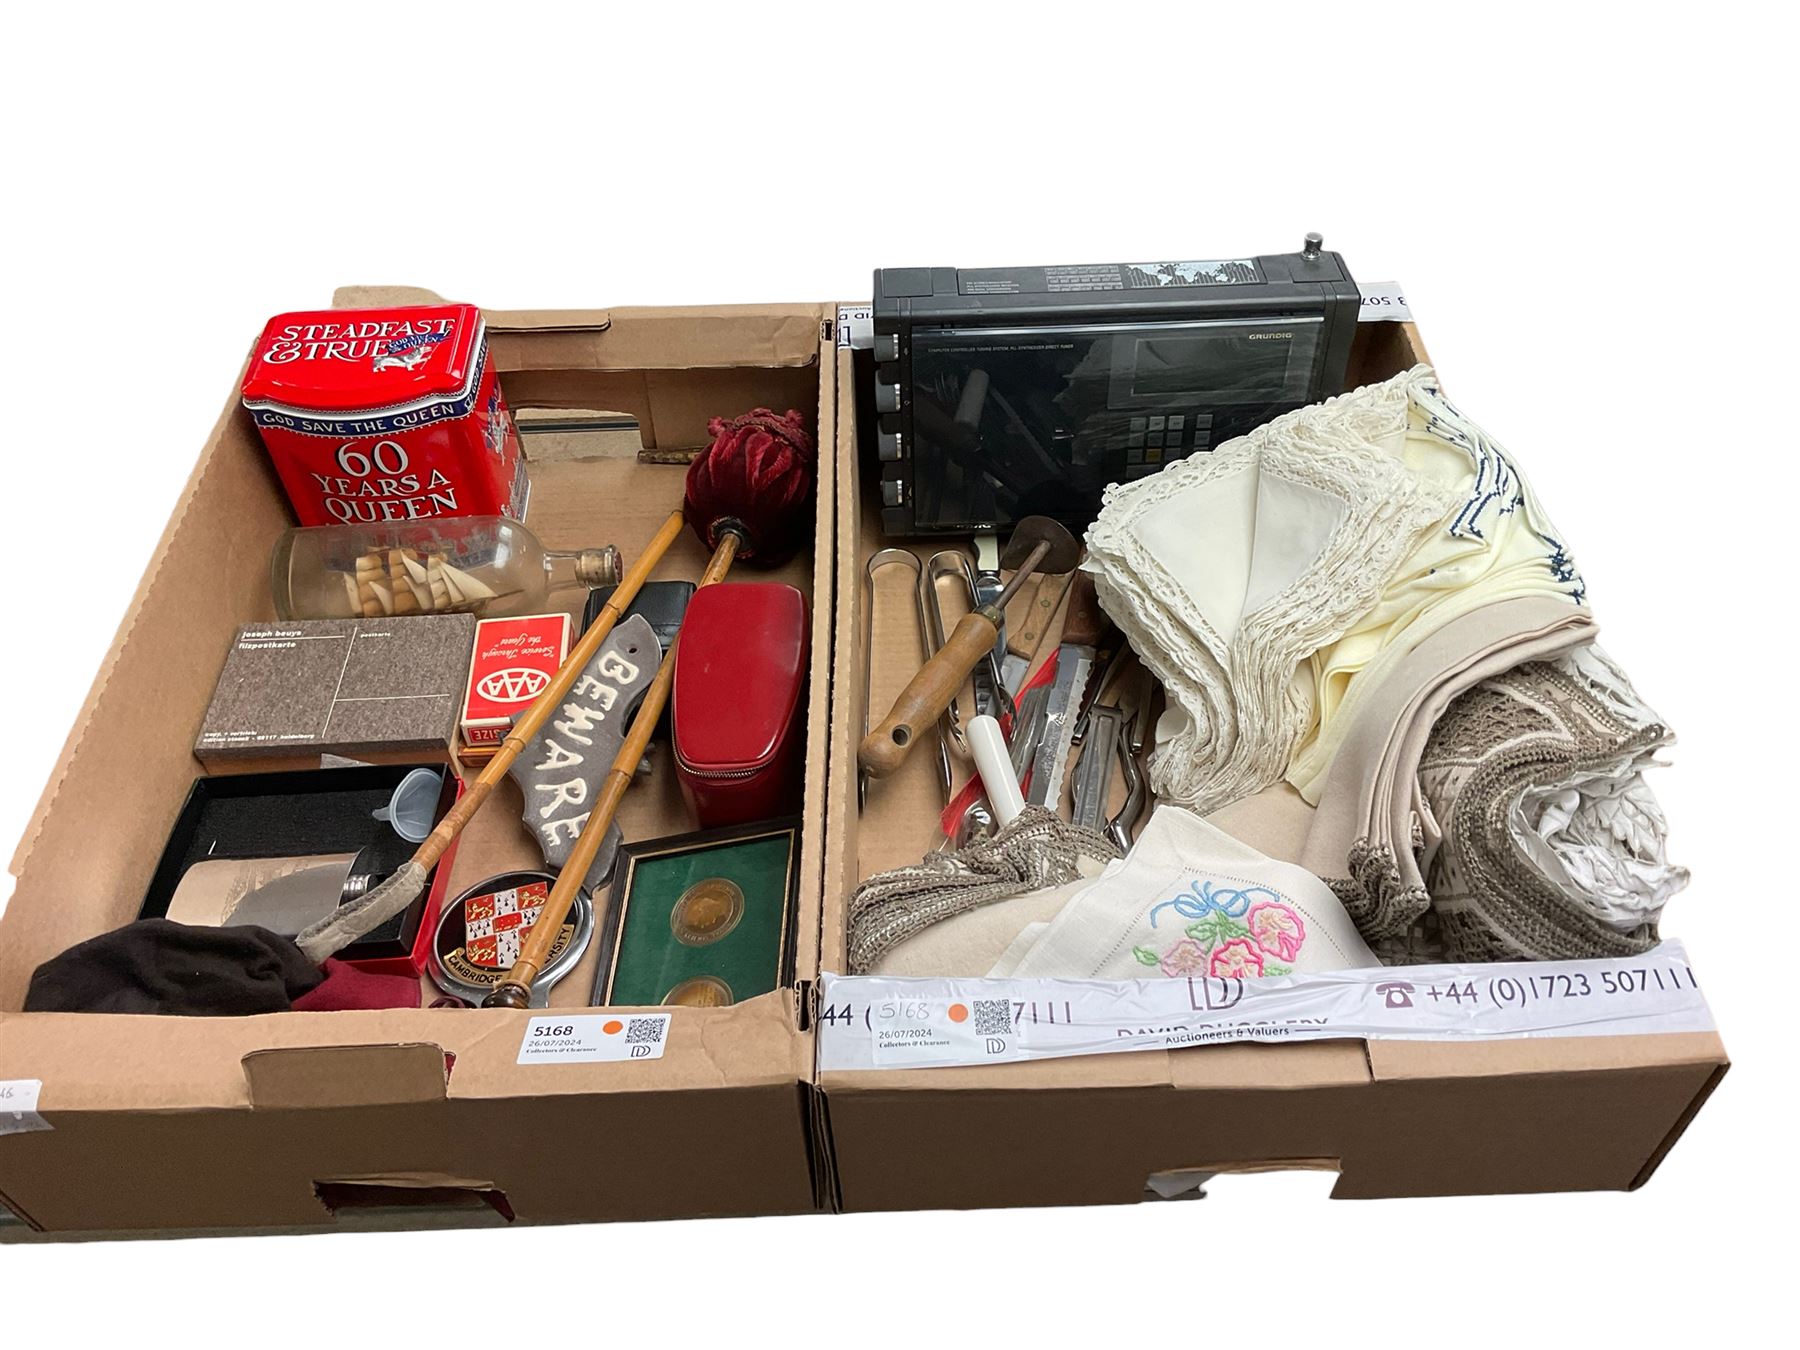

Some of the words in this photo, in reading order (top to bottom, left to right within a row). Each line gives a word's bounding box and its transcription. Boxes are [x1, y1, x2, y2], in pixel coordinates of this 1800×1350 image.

[276, 318, 455, 341] STEADFAST
[1249, 332, 1292, 340] GRUNDIG
[262, 413, 295, 426] GOD
[302, 420, 346, 433] SAVE
[351, 419, 388, 432] THE
[392, 404, 454, 427] QUEEN
[337, 440, 409, 477] 60
[311, 471, 420, 498] YEARS
[428, 468, 452, 489] A
[325, 488, 458, 526] QUEEN
[242, 631, 272, 639] joseph
[528, 636, 541, 646] the
[239, 642, 296, 650] filzpostkarte
[486, 670, 544, 699] AAA
[474, 730, 499, 740] SIZE
[535, 650, 640, 846] BEWARE
[448, 955, 503, 984] CAMBRIDGE
[1426, 980, 1478, 1004] +44
[1489, 973, 1592, 1009] (0)1723
[1600, 967, 1698, 994] 507111
[879, 1001, 930, 1020] 5168
[533, 1025, 574, 1037] 5168
[879, 1028, 932, 1040] 26/07/2024
[1165, 1029, 1233, 1045] Auctioneers
[1236, 1028, 1243, 1038] &
[1247, 1026, 1290, 1037] Valuers
[528, 1039, 582, 1048] 26/07/2024
